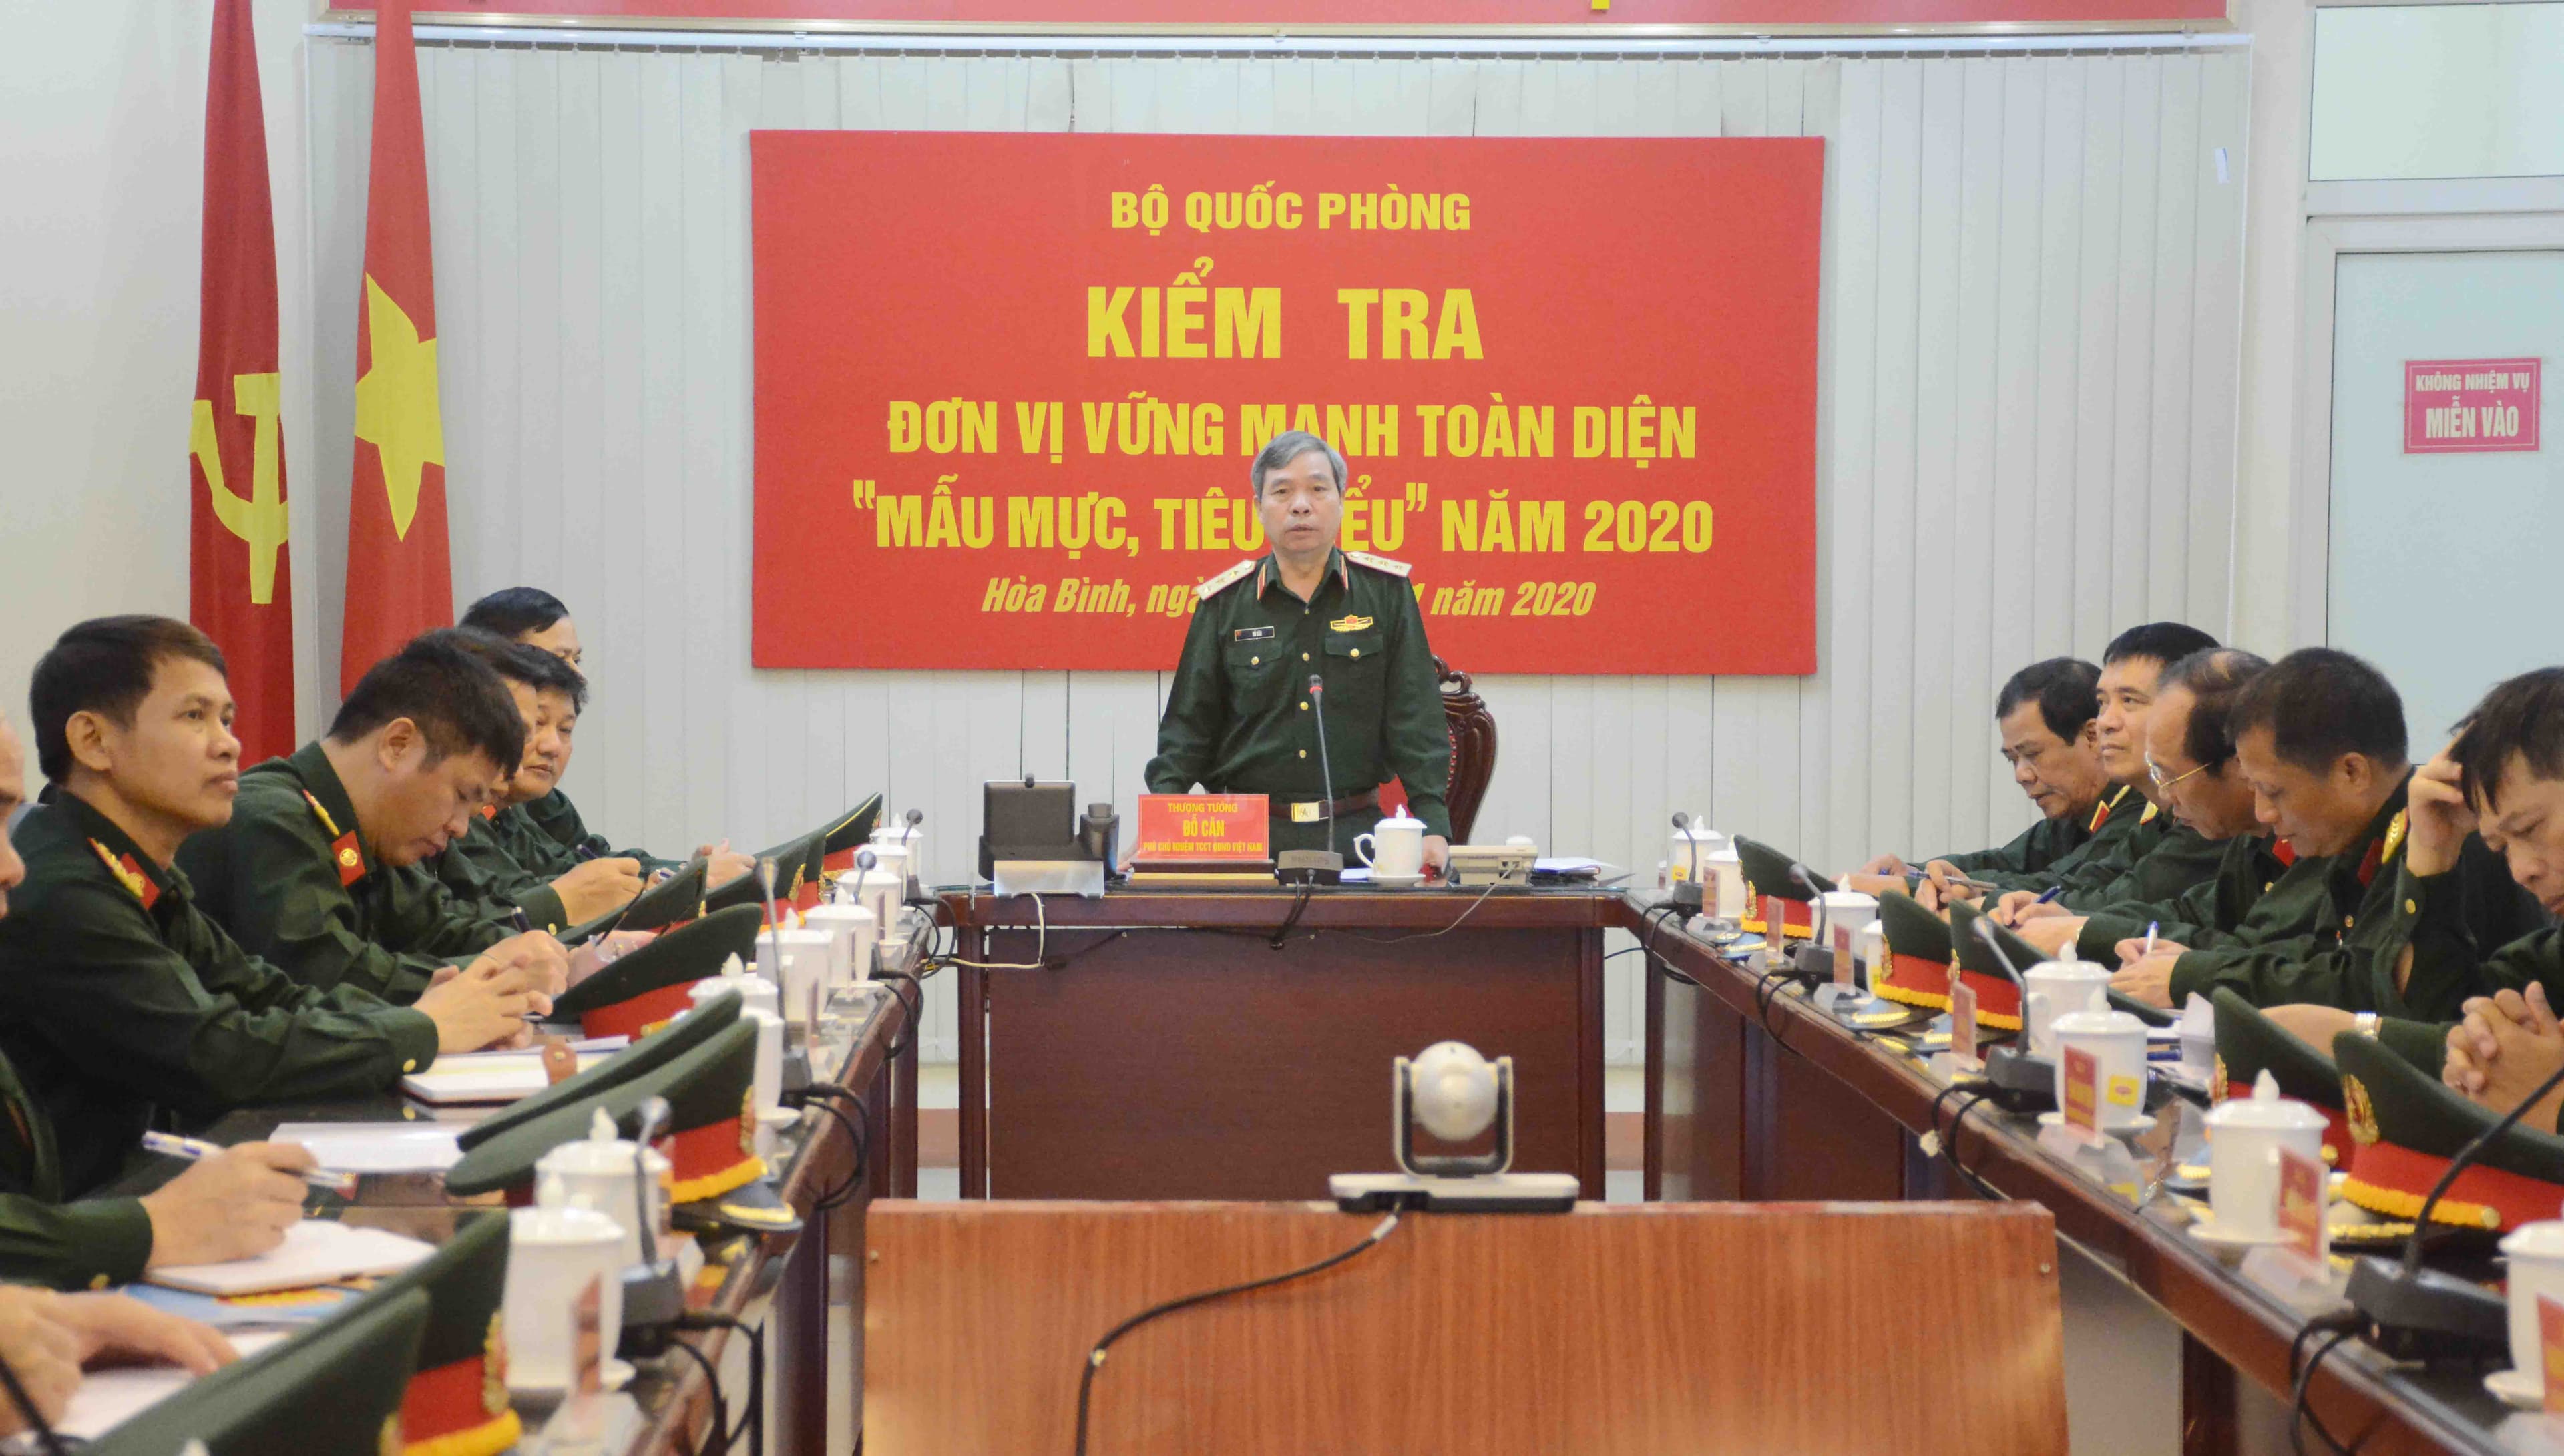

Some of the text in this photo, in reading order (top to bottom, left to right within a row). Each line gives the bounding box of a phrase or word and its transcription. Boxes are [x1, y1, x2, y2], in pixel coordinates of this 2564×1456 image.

[1111, 180, 1470, 236] BỘ QUỐC PHÒNG
[1087, 256, 1484, 360] KIỂM TRA
[2416, 370, 2530, 393] KHÔNG NHIỆM VỤ
[887, 397, 998, 454] ĐƠN
[1016, 401, 1064, 464] VỊ
[1082, 391, 1225, 456] VỮNG
[1416, 392, 1555, 458] TOÀN
[1573, 394, 1697, 469] DIỆN
[2426, 395, 2519, 438] MIỄN VÀO
[1008, 491, 1139, 559] MỰC,
[1153, 486, 1266, 551] TIÊU
[1441, 489, 1566, 553] NĂM
[1583, 499, 1713, 553] 2020
[981, 575, 1047, 612] Hòa
[1053, 577, 1136, 617] Bình,
[1430, 579, 1505, 616] năm
[1510, 581, 1597, 616] 2020
